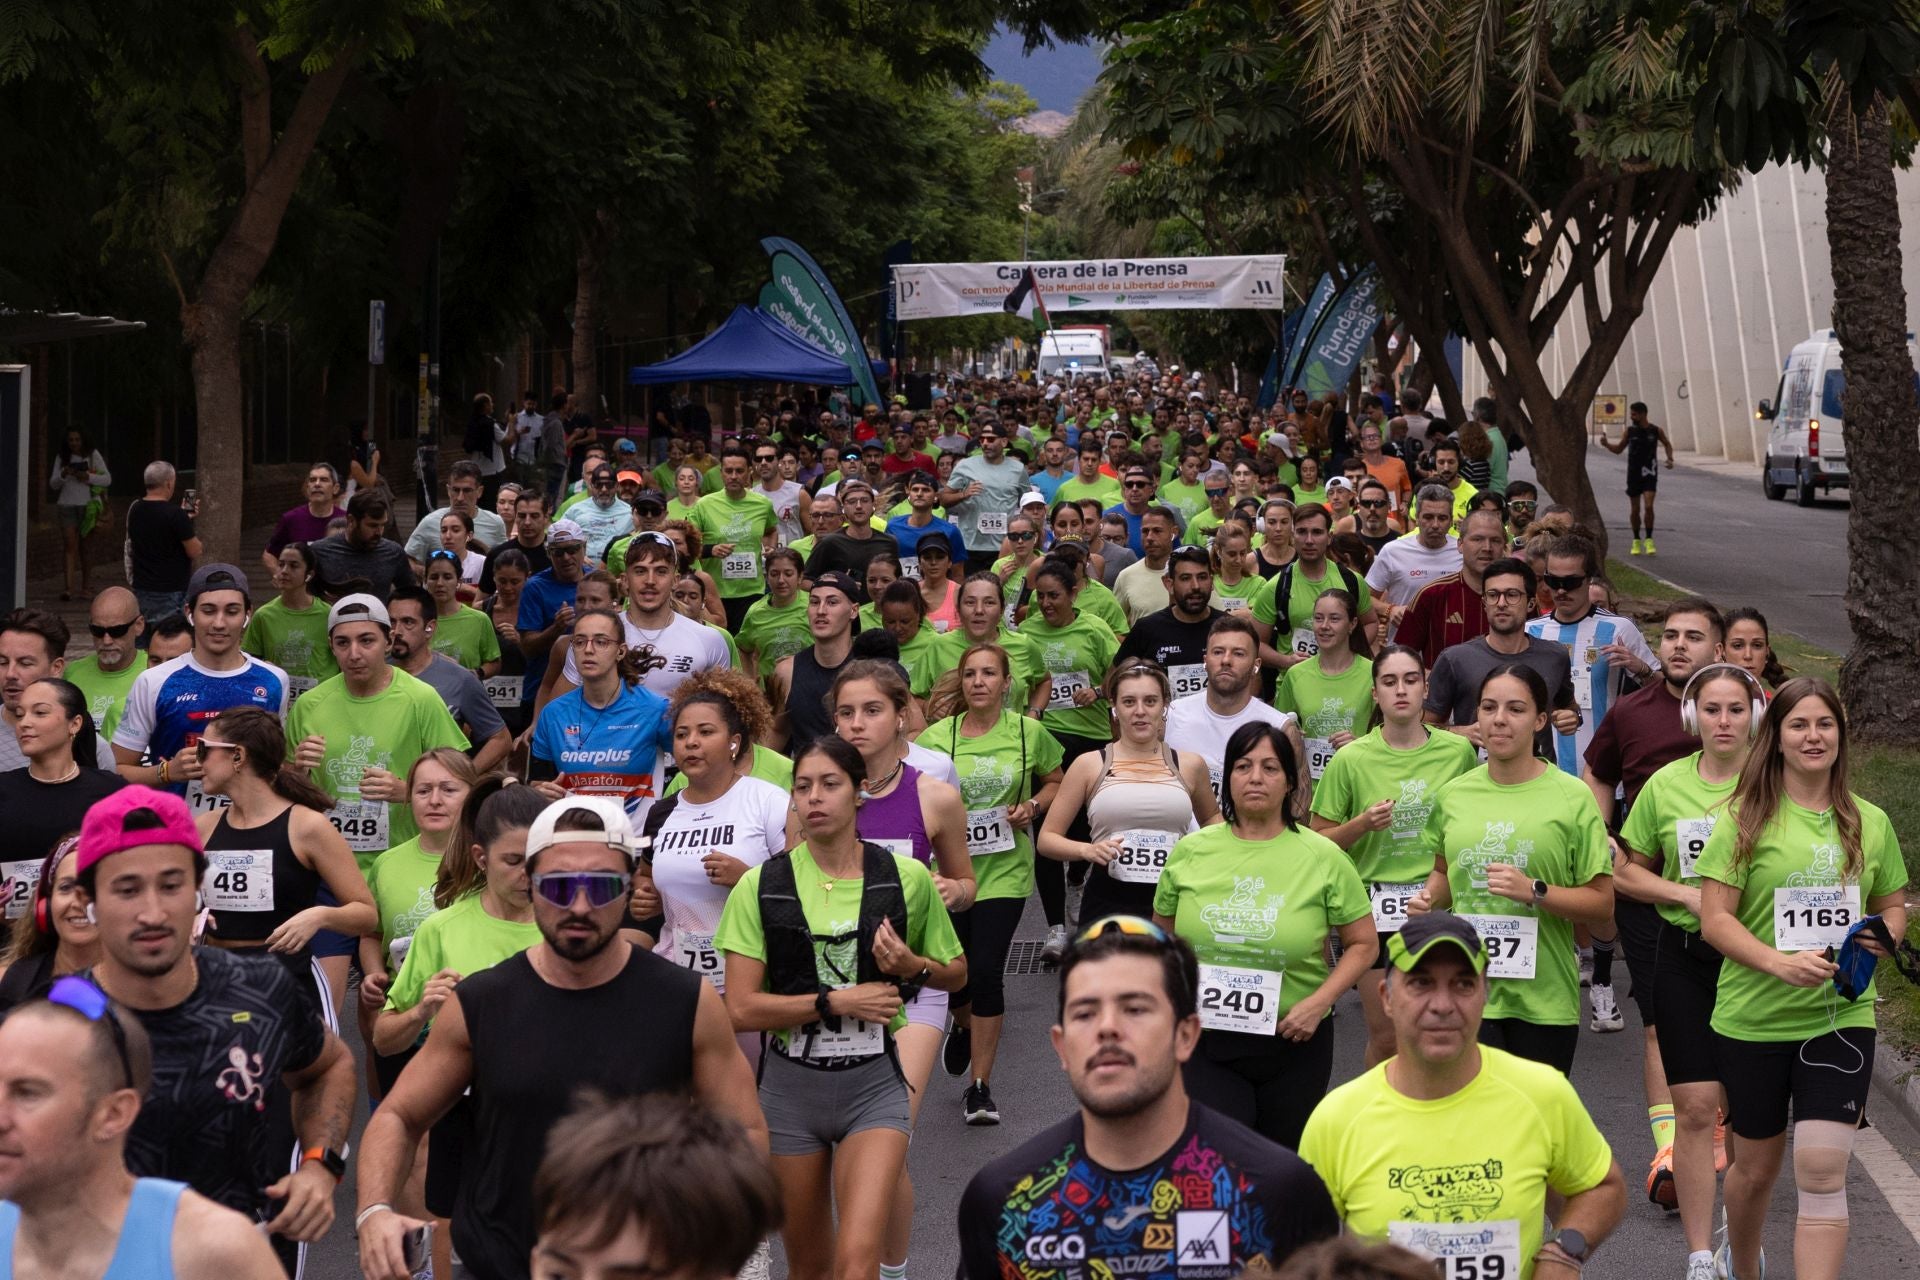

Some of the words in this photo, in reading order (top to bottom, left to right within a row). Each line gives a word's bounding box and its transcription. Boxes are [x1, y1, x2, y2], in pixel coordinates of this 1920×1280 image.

[996, 264, 1067, 281] Carera
[1073, 263, 1097, 279] de
[1102, 262, 1119, 277] la
[1124, 262, 1188, 277] Prensa
[962, 286, 980, 296] con
[983, 283, 1014, 296] motiv
[1057, 281, 1095, 292] Mundial
[1098, 281, 1110, 291] de
[1113, 280, 1121, 290] la
[1124, 279, 1166, 291] Libertad
[1168, 278, 1180, 289] de
[1183, 277, 1216, 289] Prensa
[981, 519, 1003, 528] 515
[727, 560, 753, 572] 352
[488, 686, 517, 698] 941
[560, 749, 632, 768] enerplus
[569, 773, 624, 788] Maratón
[659, 824, 735, 854] FITCLUB
[1118, 846, 1168, 867] 858
[1688, 839, 1706, 860] 9
[213, 872, 248, 893] 48
[1783, 908, 1850, 928] 1163
[684, 950, 718, 971] 75
[1202, 987, 1264, 1014] 240
[1178, 1239, 1220, 1260] AXA
